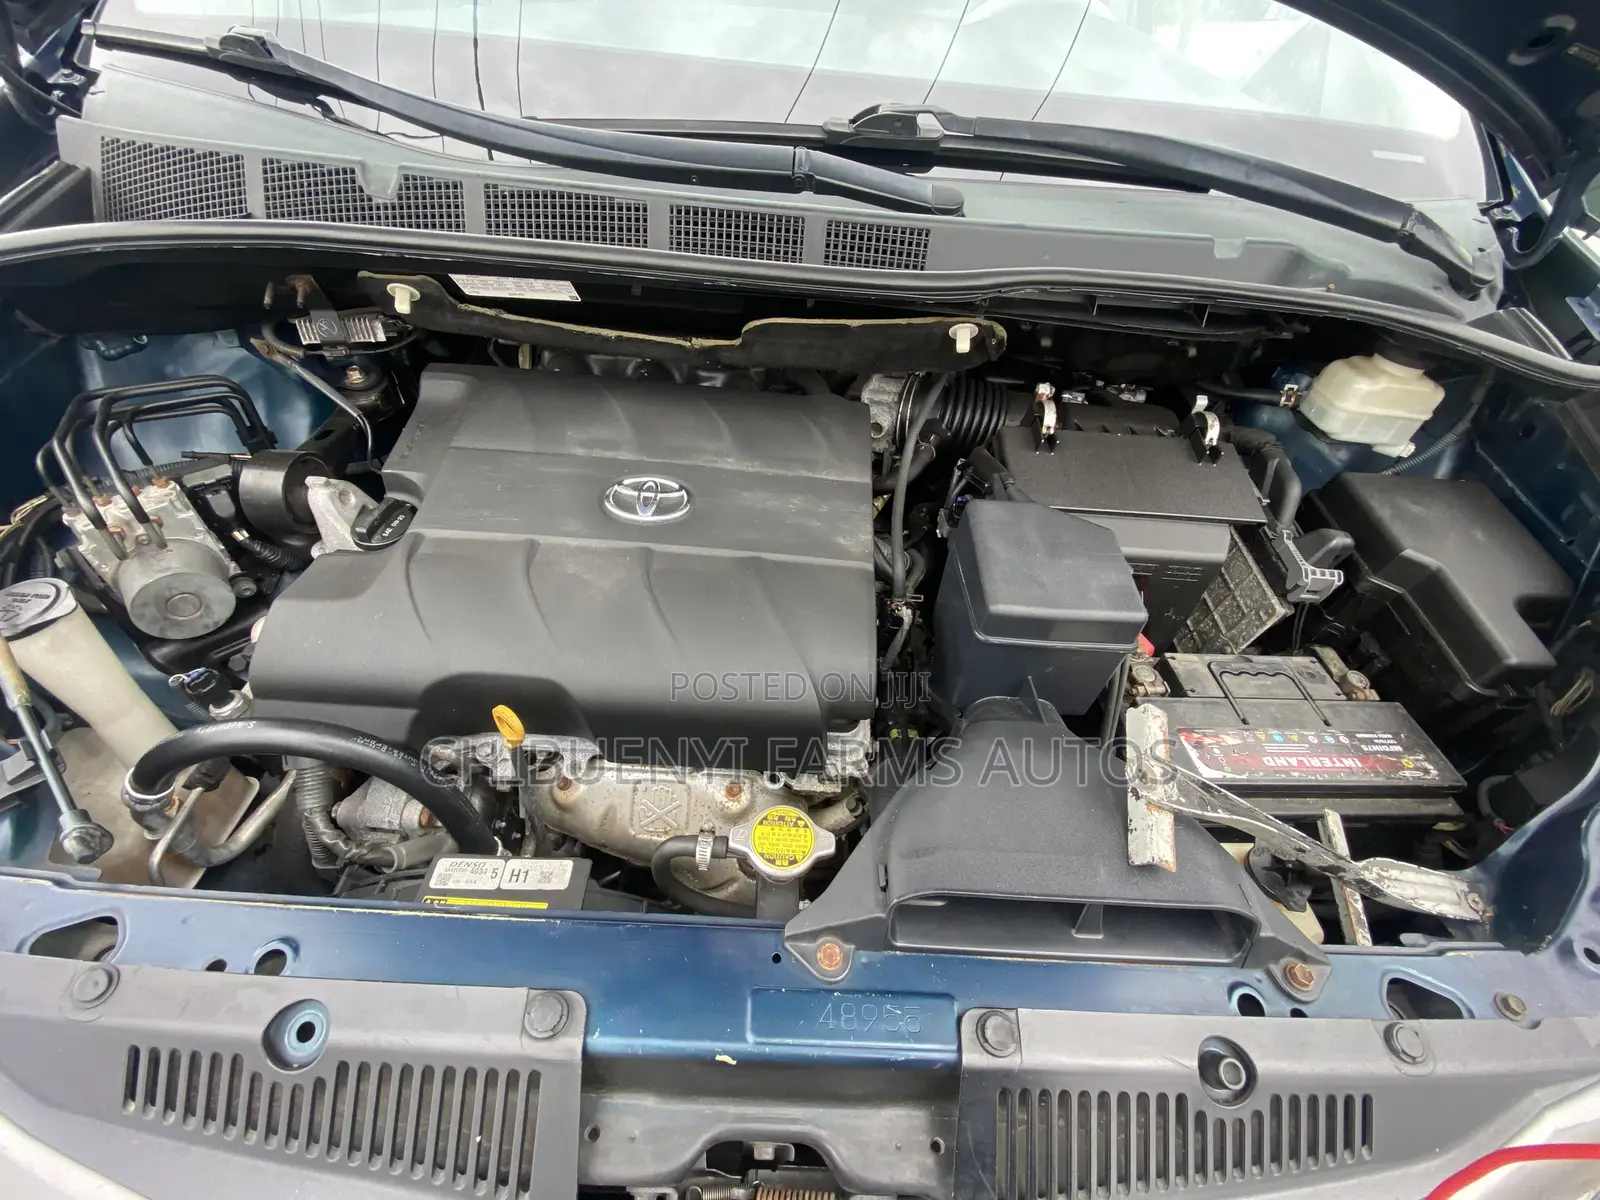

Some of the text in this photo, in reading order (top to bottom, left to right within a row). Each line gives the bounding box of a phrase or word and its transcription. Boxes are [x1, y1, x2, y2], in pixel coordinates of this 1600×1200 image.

[1262, 756, 1362, 768] INTERLAND
[762, 819, 795, 828] ATTENTION
[763, 853, 795, 861] CAUTION
[490, 868, 499, 879] 5
[508, 868, 529, 883] H1
